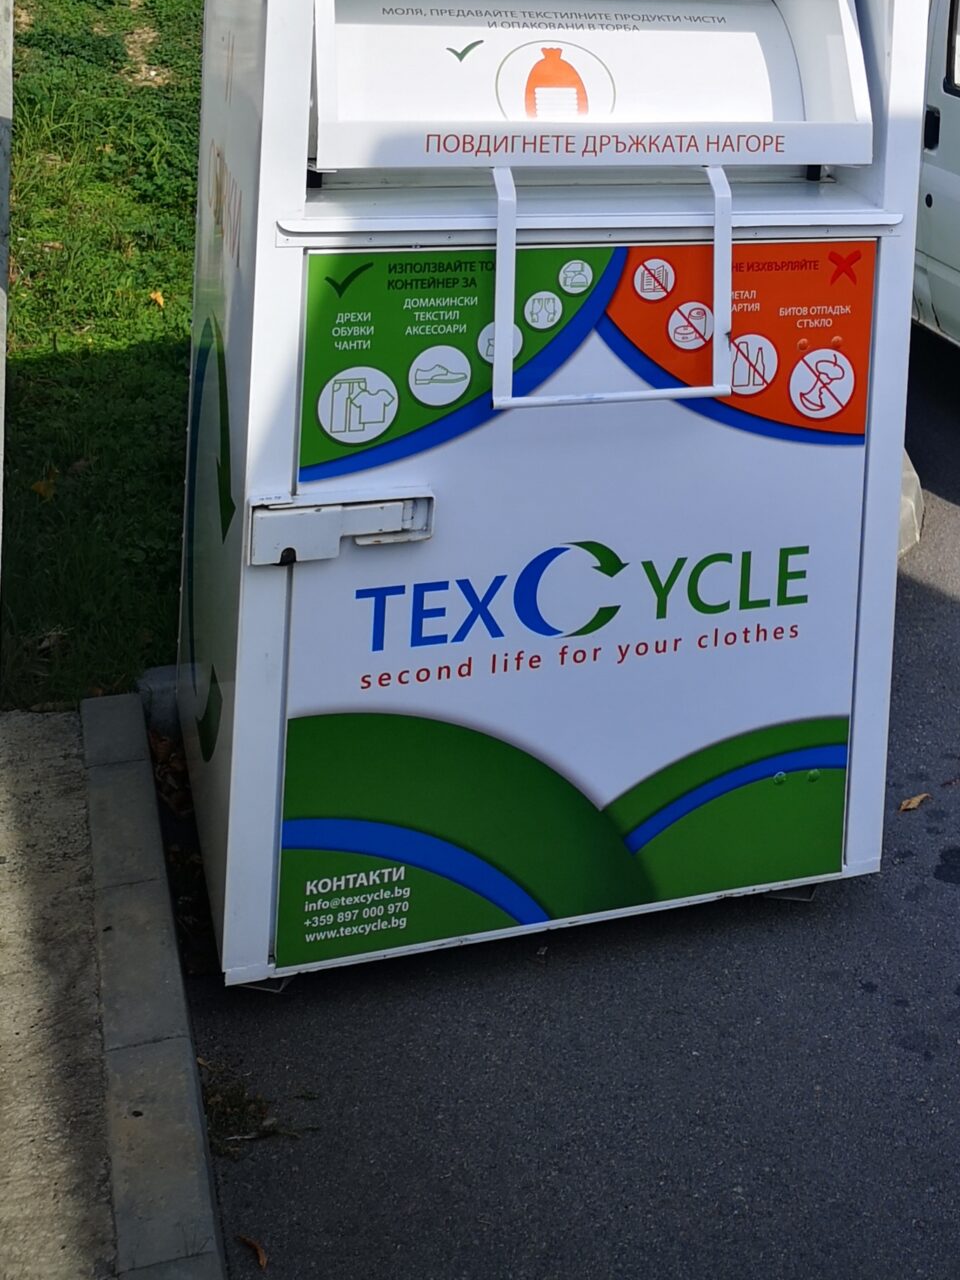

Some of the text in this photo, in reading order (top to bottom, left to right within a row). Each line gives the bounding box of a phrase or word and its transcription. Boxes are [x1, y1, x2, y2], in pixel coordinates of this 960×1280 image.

[381, 7, 727, 24] МОЛЯ, ПРЕДАВАЙТЕ ТЕКСТИЛНИТЕ ПРОДУКТИ ЧИСТИ
[487, 20, 497, 29] И
[500, 21, 584, 31] ОПАКОВАНИ
[598, 24, 640, 32] ТОРБА
[425, 134, 786, 157] ПОВДИГНЕТЕ ДРЪЖКАТА НАГОРЕ
[388, 260, 496, 274] ИЗПОЛЗВАЙТЕ ТО
[746, 259, 820, 272] ИЗХВЪРЛЯЙТЕ
[387, 277, 477, 290] КОНТЕЙНЕР ЗА
[403, 296, 478, 310] ДОМАКИНСКИ
[731, 302, 761, 312] АРТИЯ
[413, 310, 460, 322] ТЕКСТИЛ
[779, 305, 852, 317] БИТОВ ОТПАДЪК
[336, 312, 372, 324] ДРЕХИ
[796, 318, 833, 329] СТЪКЛО
[332, 326, 375, 337] ОБУВКИ
[405, 324, 467, 336] АКСЕСОАРИ
[334, 340, 371, 350] ЧАНТИ
[360, 622, 800, 689] second life for your clothes
[305, 866, 406, 896] КОНТАКТИ
[304, 886, 411, 912] info@texcycle.bg
[304, 901, 409, 928] +359 897 000 970
[305, 916, 407, 943] www.texcycle.bg
